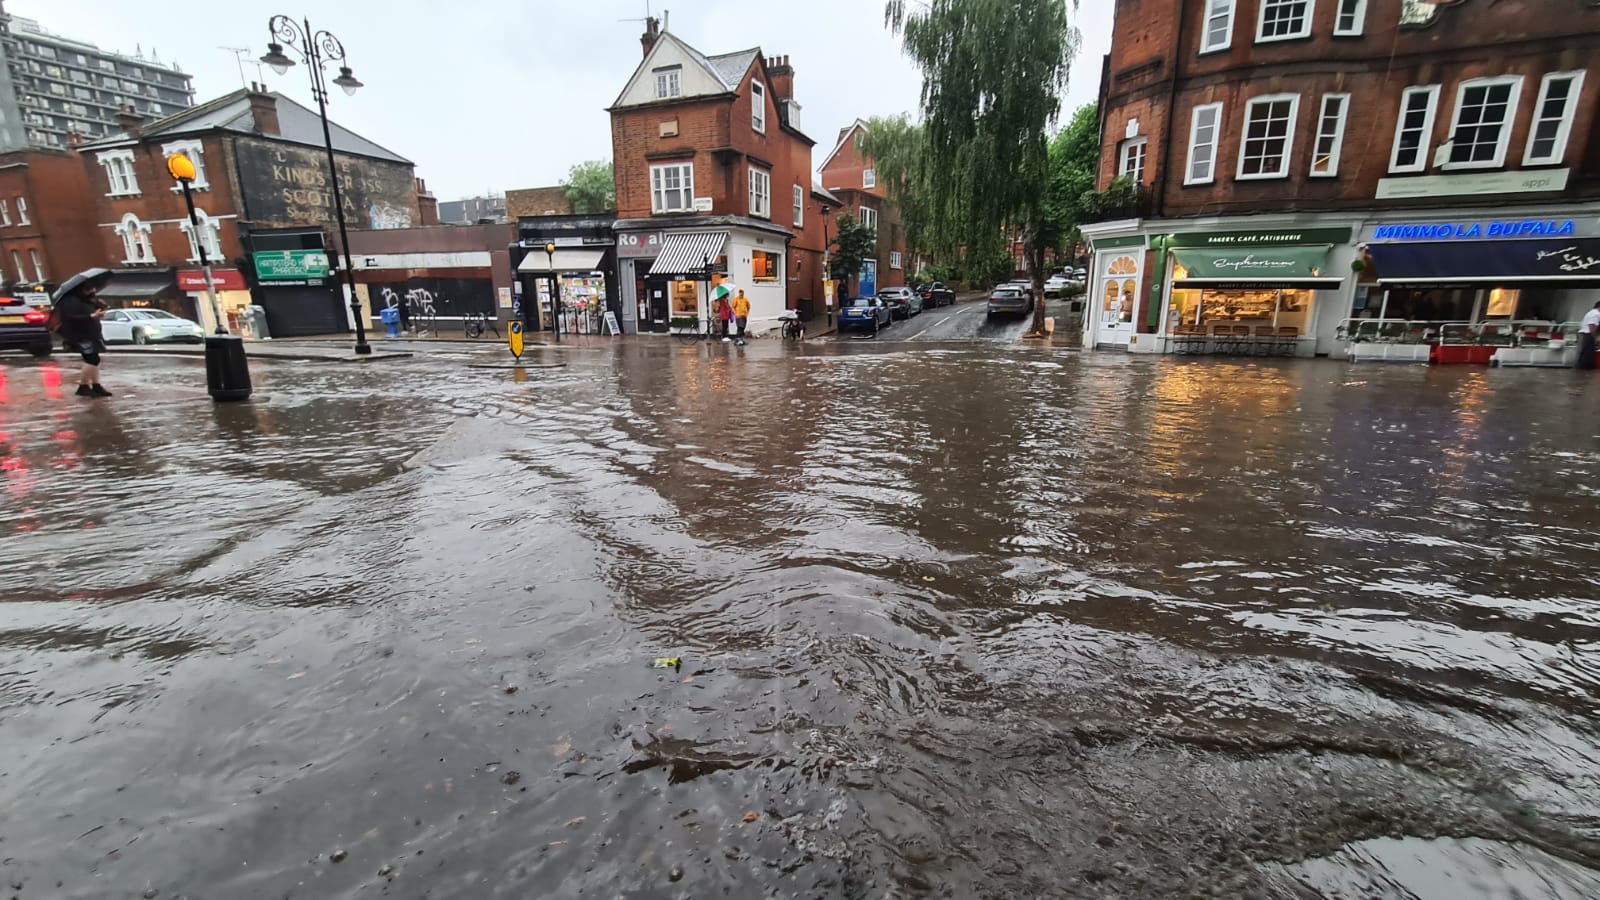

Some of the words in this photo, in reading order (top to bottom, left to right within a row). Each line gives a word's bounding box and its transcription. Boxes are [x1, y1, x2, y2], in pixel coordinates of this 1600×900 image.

[1374, 224, 1453, 239] MIMMO
[1455, 223, 1480, 236] LA
[1485, 220, 1575, 237] BUFALA
[618, 232, 664, 248] Royal
